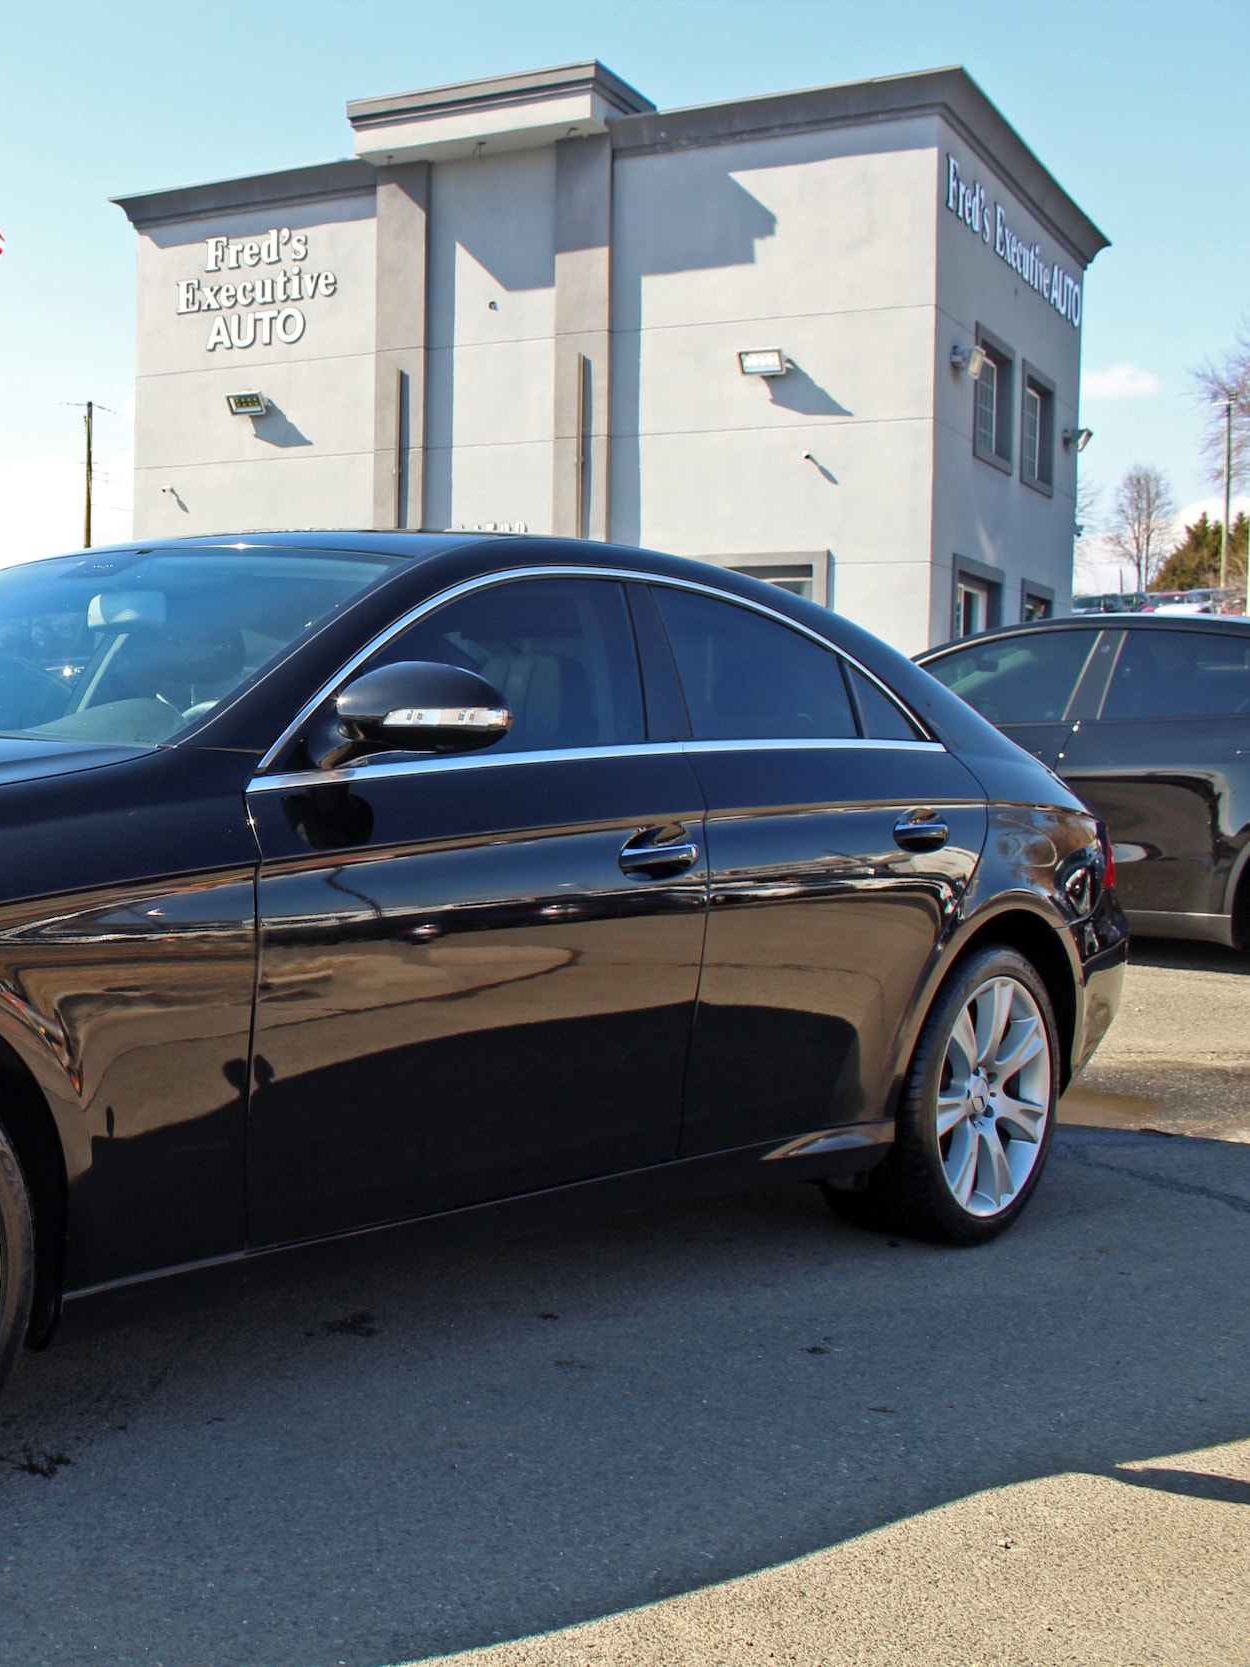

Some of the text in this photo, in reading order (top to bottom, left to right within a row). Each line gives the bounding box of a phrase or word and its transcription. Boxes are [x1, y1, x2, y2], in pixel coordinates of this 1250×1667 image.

[205, 227, 308, 273] Fred's
[947, 152, 1082, 328] Fred's Executive AUTO
[176, 265, 338, 315] Executive
[206, 306, 306, 352] AUTO
